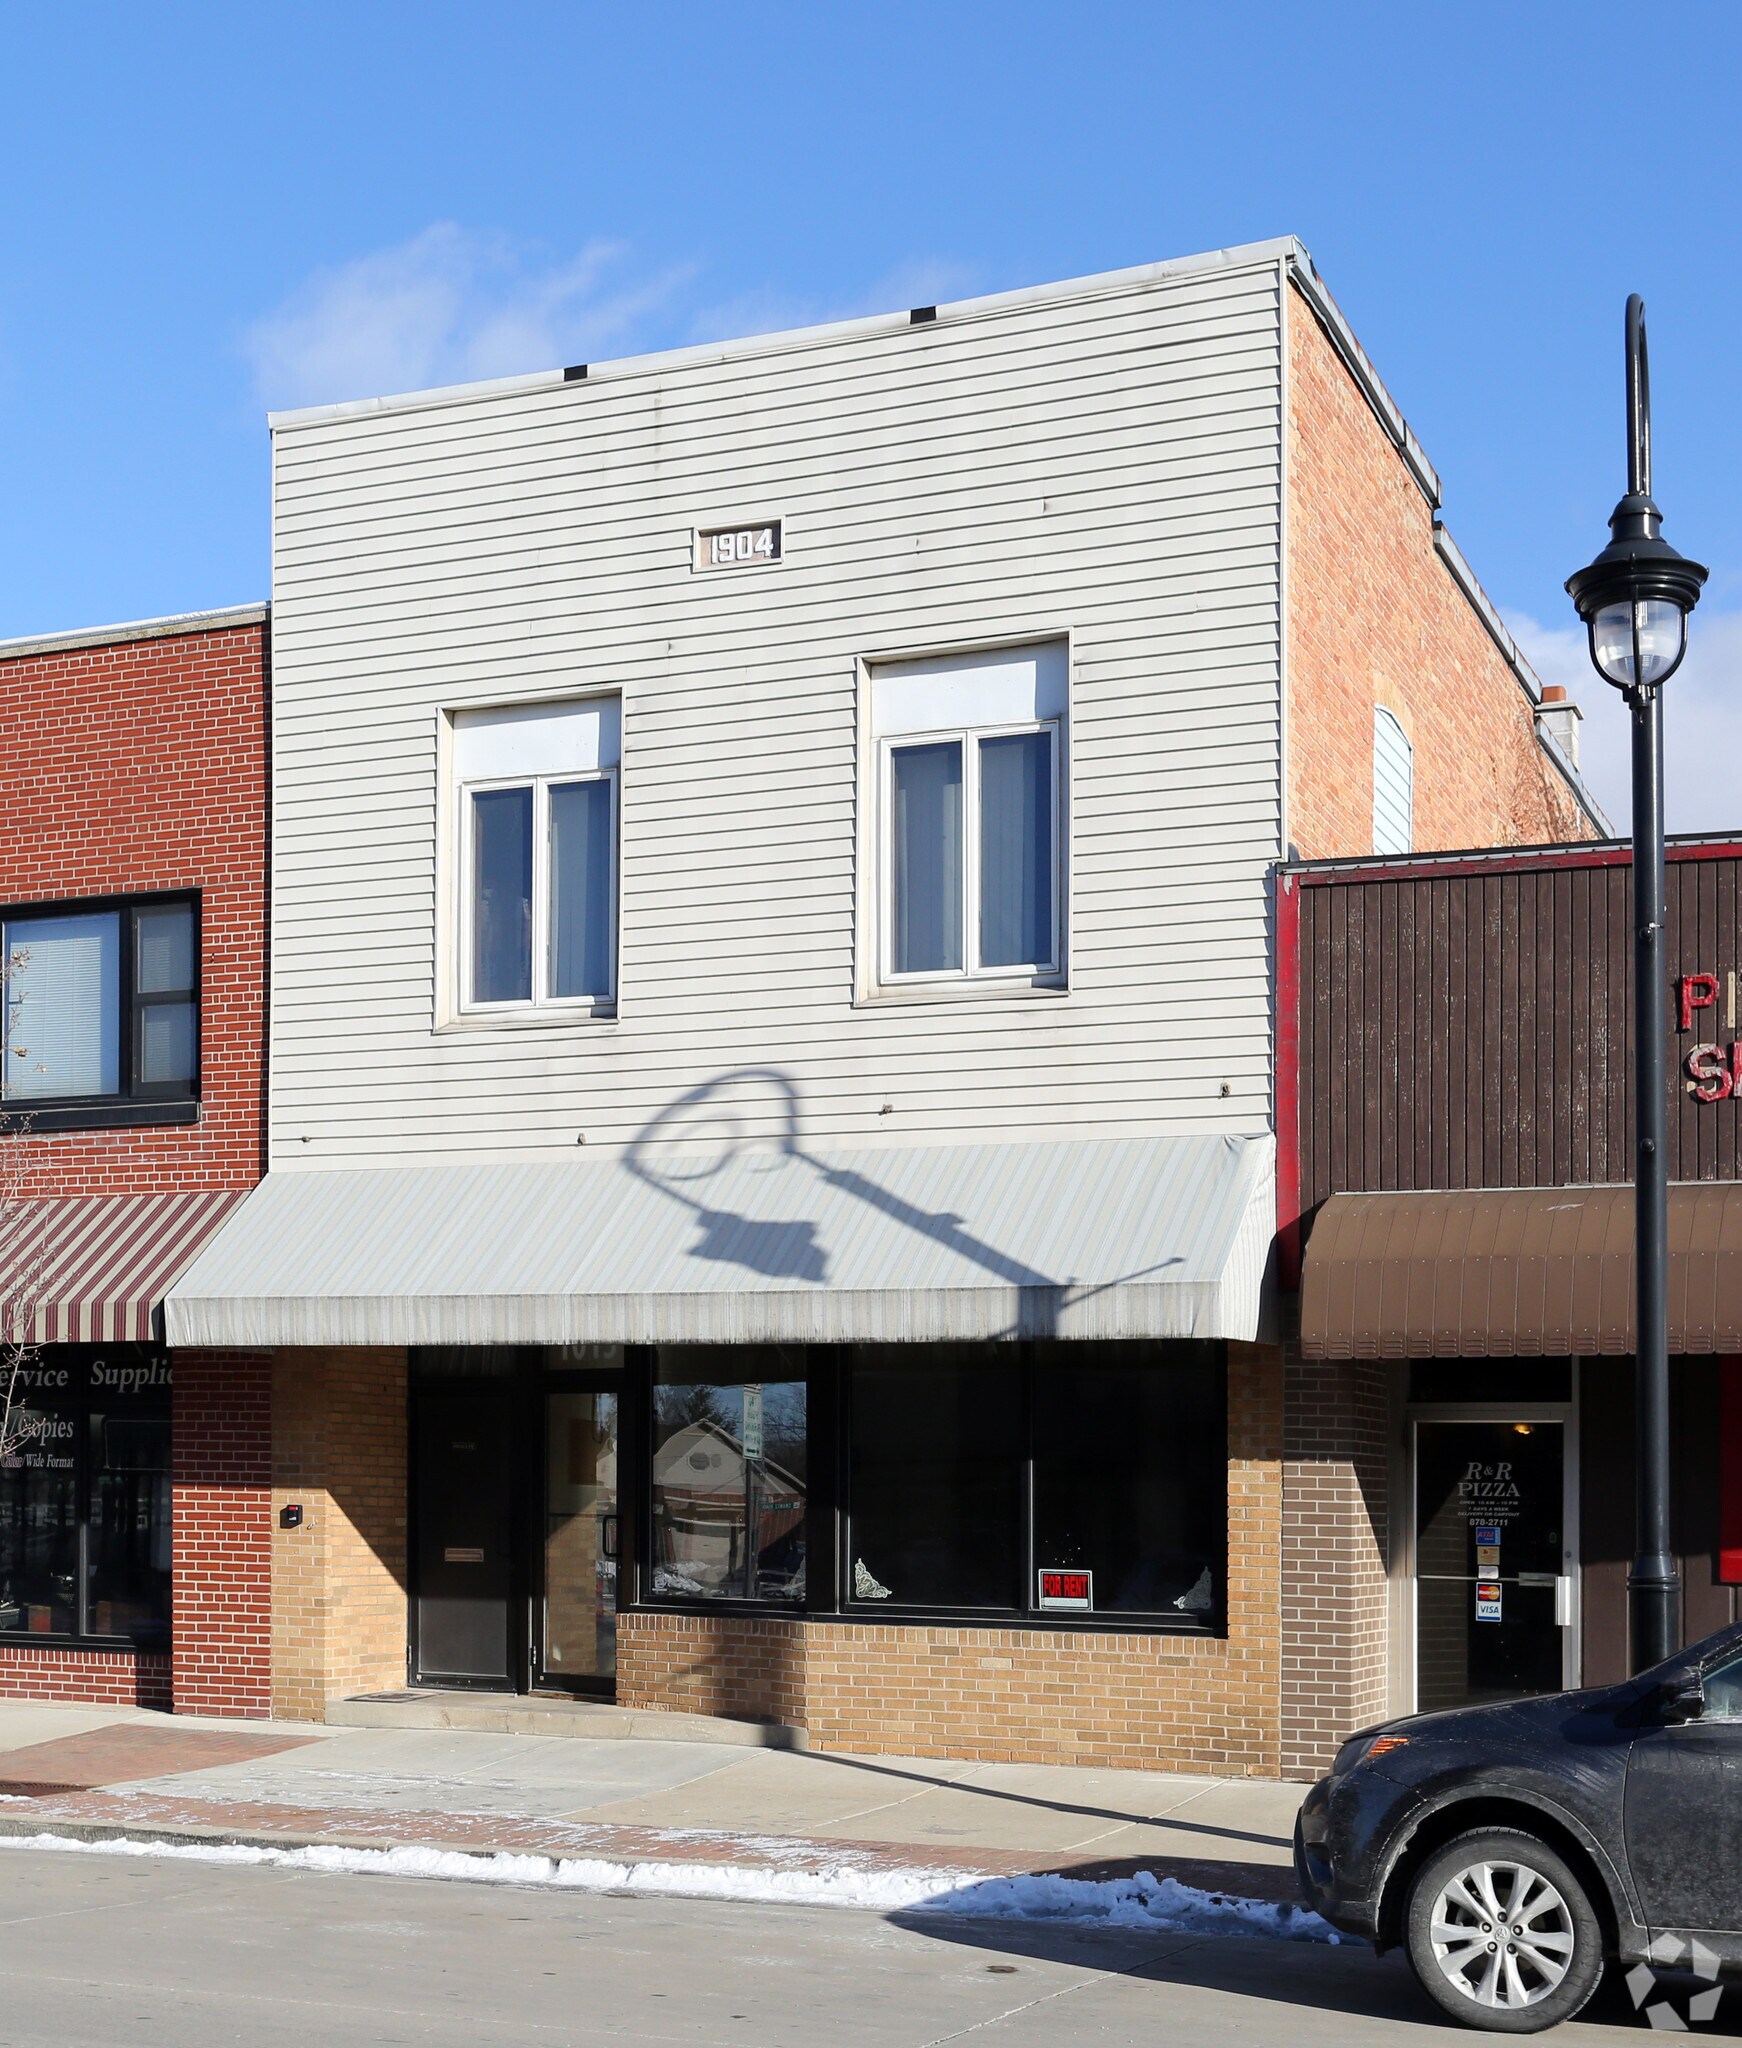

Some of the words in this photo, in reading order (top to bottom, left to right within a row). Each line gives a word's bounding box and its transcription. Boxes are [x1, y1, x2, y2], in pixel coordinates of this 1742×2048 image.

[711, 528, 774, 564] 1904
[47, 1454, 74, 1468] Format
[1457, 1481, 1520, 1497] PIZZA
[1469, 1518, 1508, 1526] 878-2711
[1044, 1575, 1061, 1597] FOR
[1064, 1575, 1087, 1598] RENT
[1480, 1605, 1499, 1613] VISA
